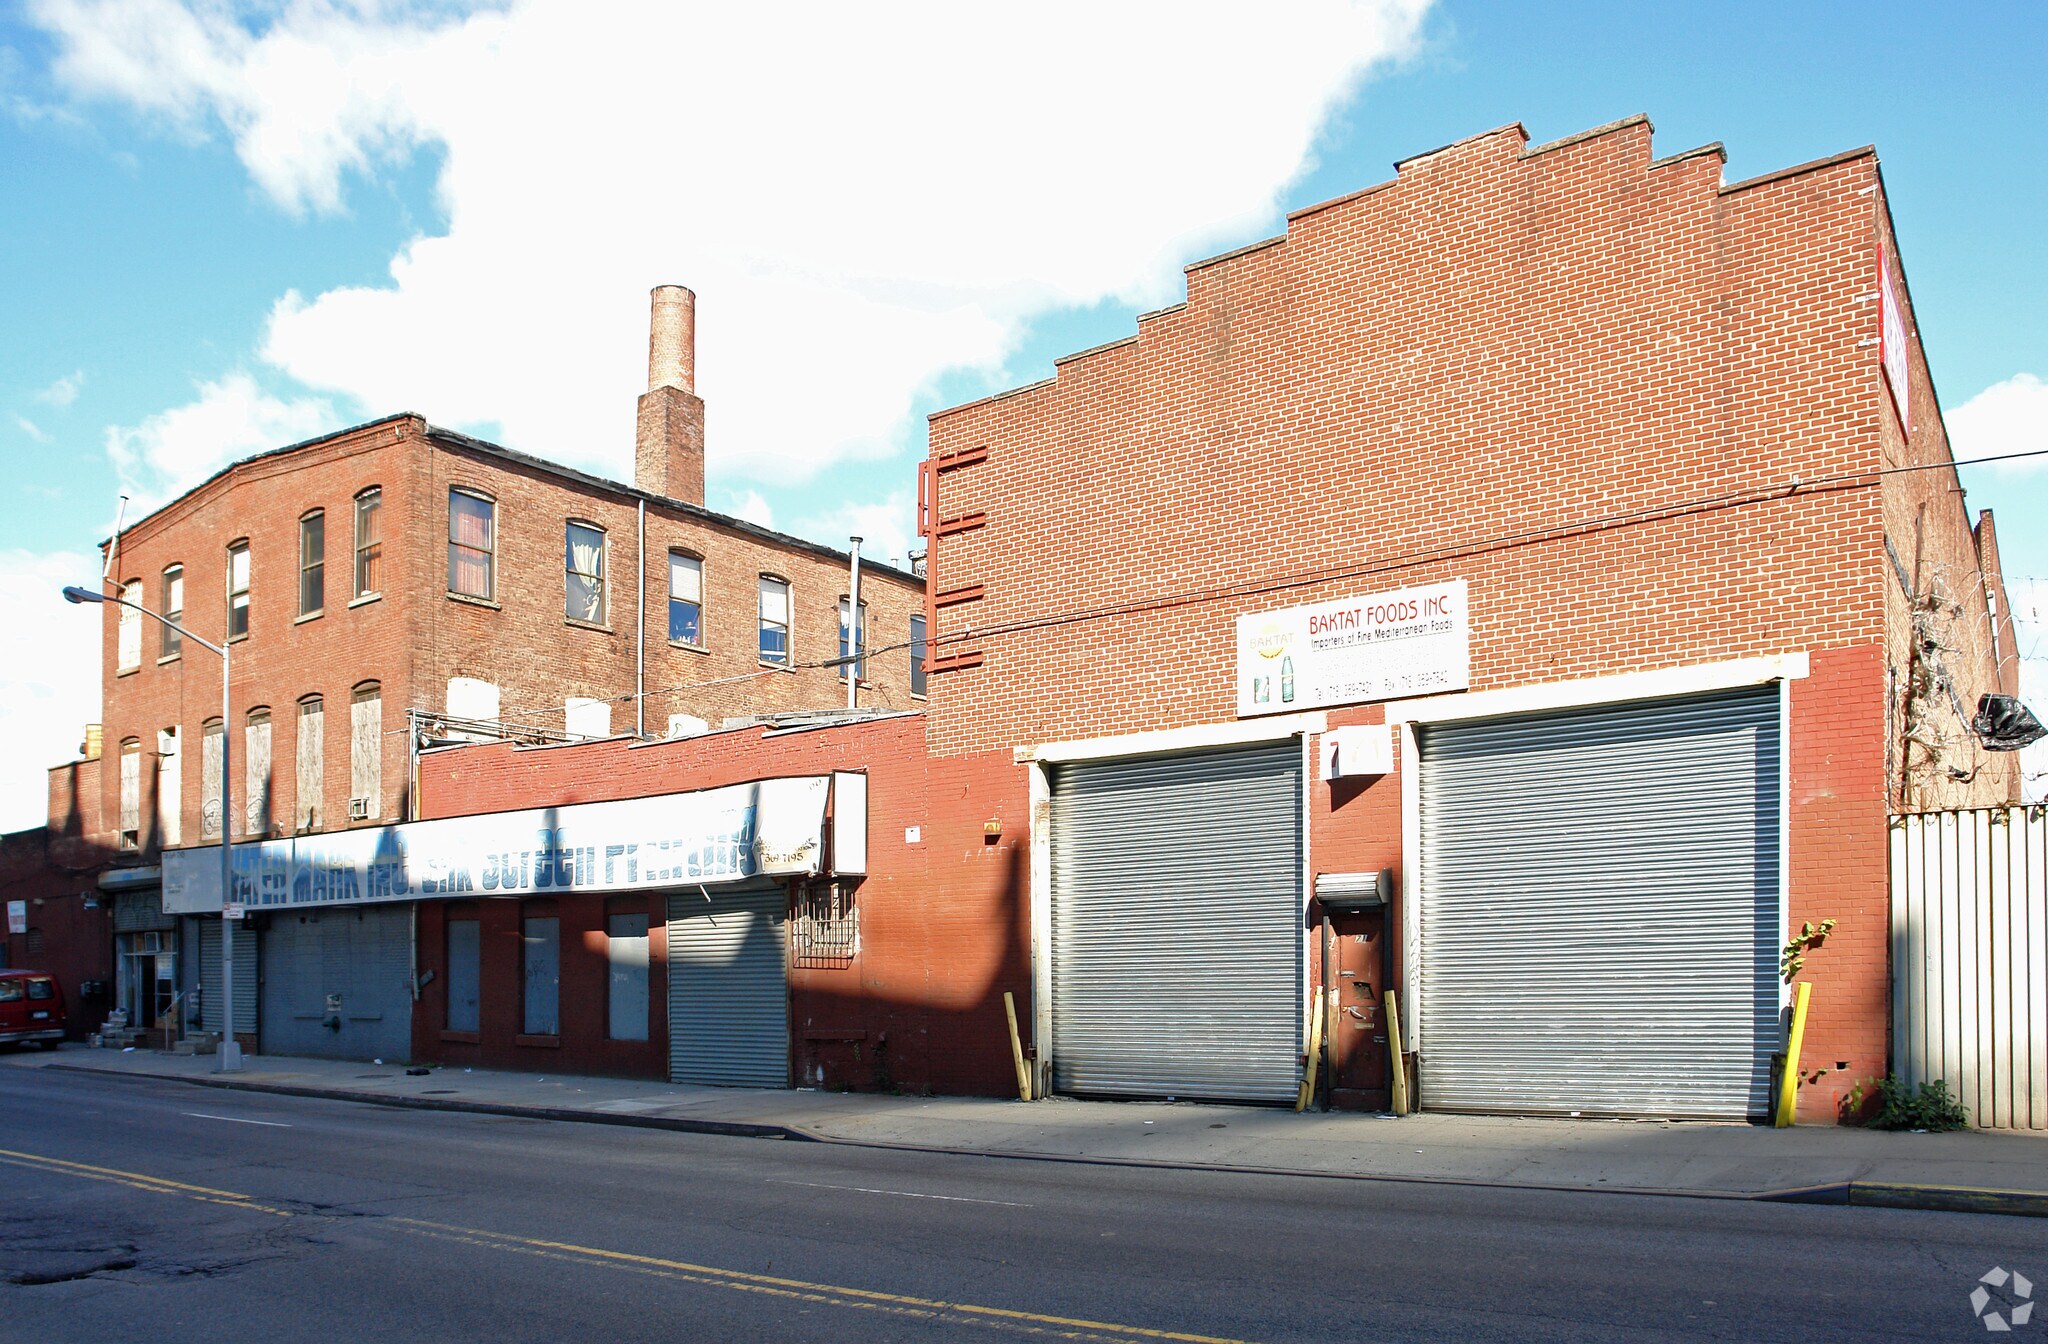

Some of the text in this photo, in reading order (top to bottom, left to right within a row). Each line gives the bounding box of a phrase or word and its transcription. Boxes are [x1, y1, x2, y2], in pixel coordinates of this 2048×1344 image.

[1309, 595, 1453, 635] BAKTAT FOODS INC.
[1249, 632, 1295, 649] BAKTAT
[1311, 635, 1344, 650] Importers
[1358, 631, 1371, 642] Fine
[1374, 624, 1428, 640] Mediterranean
[1431, 618, 1453, 630] Foods
[367, 830, 415, 898] INC.
